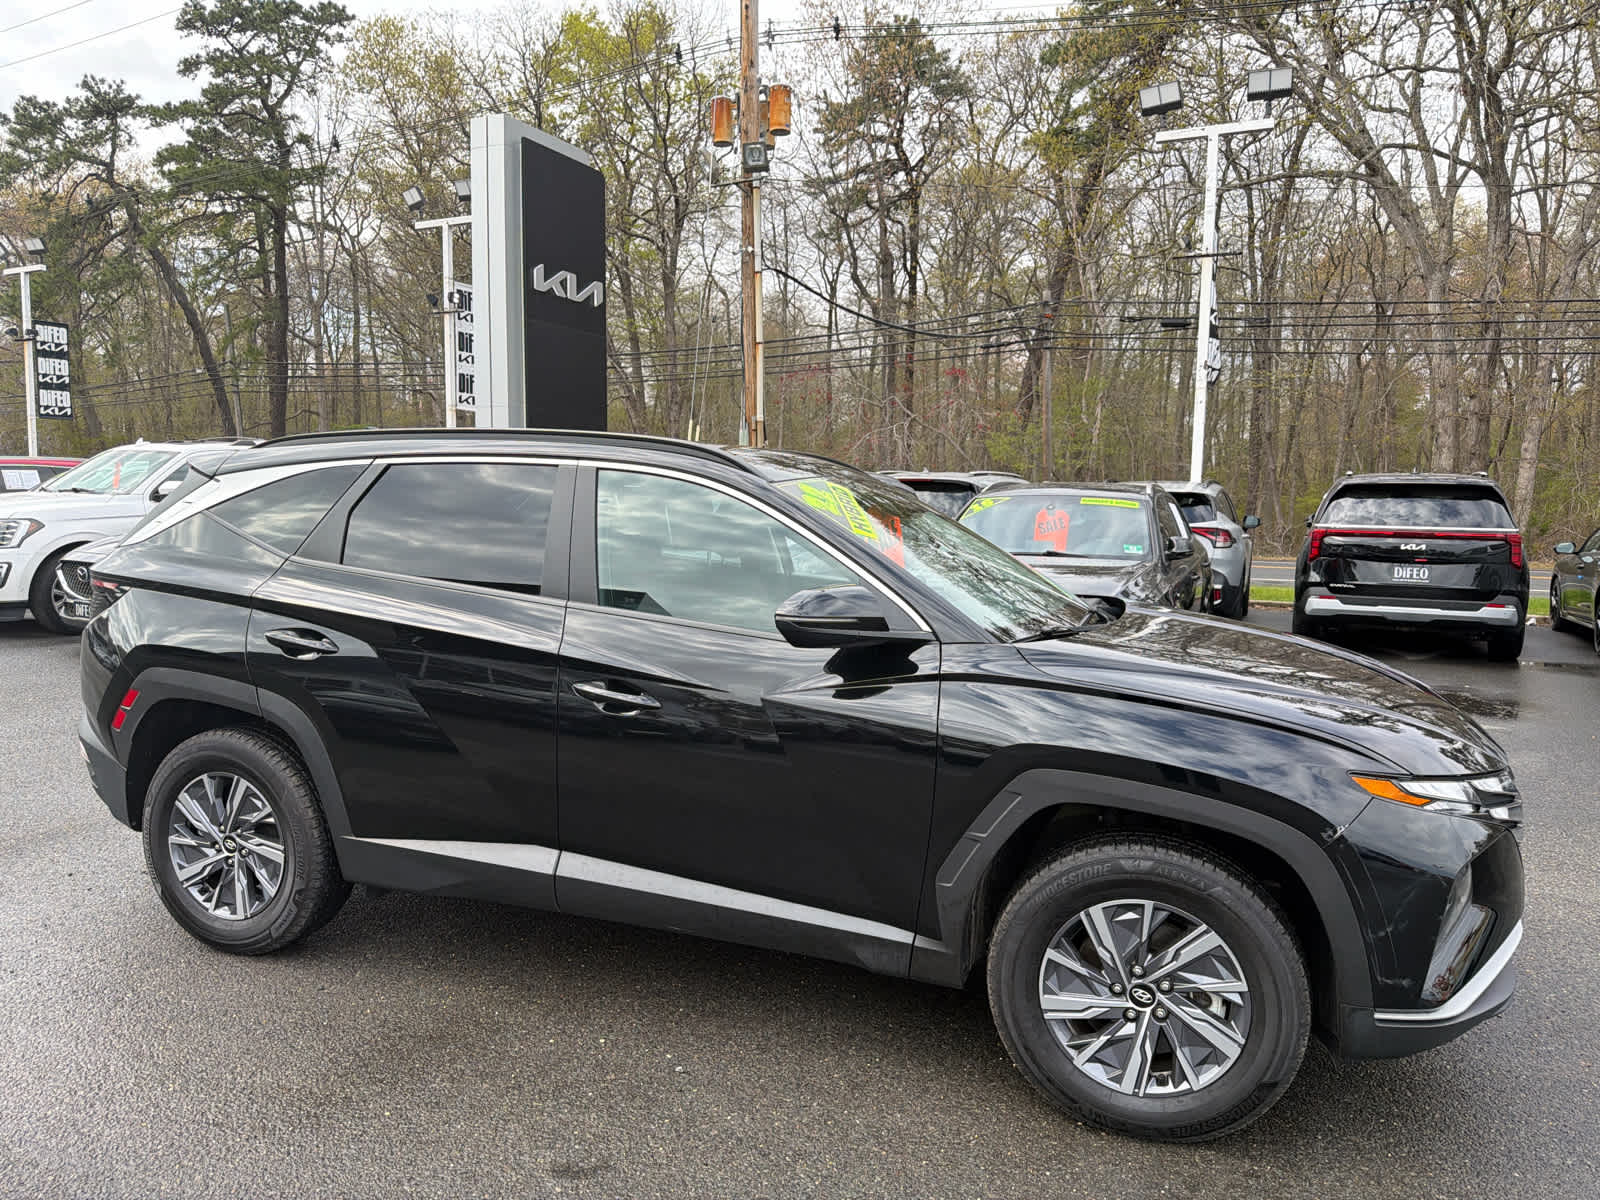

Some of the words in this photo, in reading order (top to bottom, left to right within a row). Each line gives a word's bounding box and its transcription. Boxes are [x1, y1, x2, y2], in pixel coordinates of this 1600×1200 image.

[533, 264, 603, 307] KIA
[37, 343, 68, 352] KIA
[39, 375, 69, 384] KIA
[41, 407, 71, 416] KIA
[1038, 517, 1066, 535] SALE
[75, 603, 91, 617] DiFE
